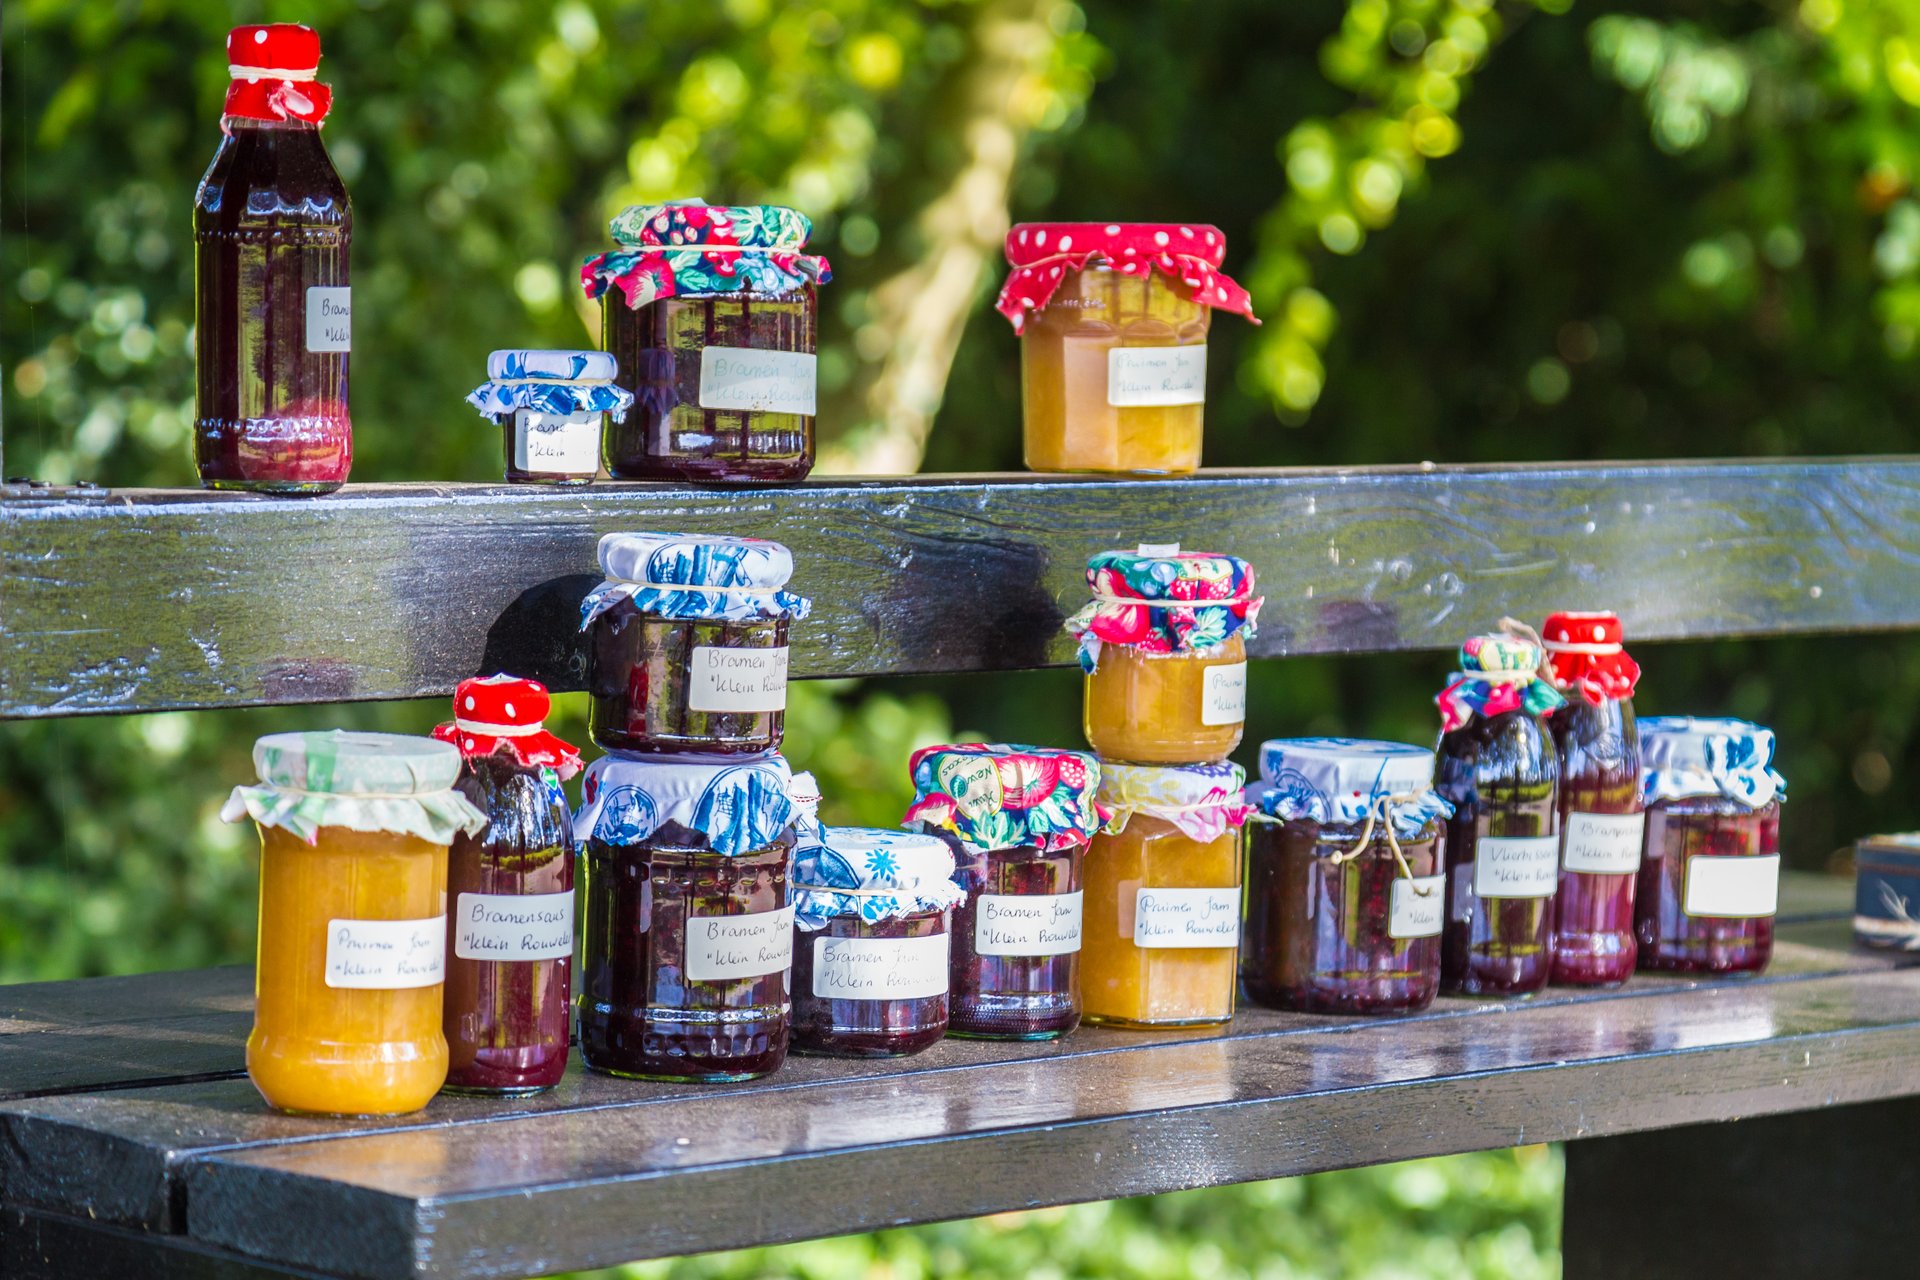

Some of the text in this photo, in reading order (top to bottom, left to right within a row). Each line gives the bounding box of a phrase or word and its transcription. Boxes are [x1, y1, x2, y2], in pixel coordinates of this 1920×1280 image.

[708, 649, 765, 668] Bramen
[987, 899, 1073, 925] Bramen Jam
[1140, 895, 1230, 920] Pruimen Jam
[707, 922, 765, 940] Bramen
[823, 945, 882, 963] Bramen
